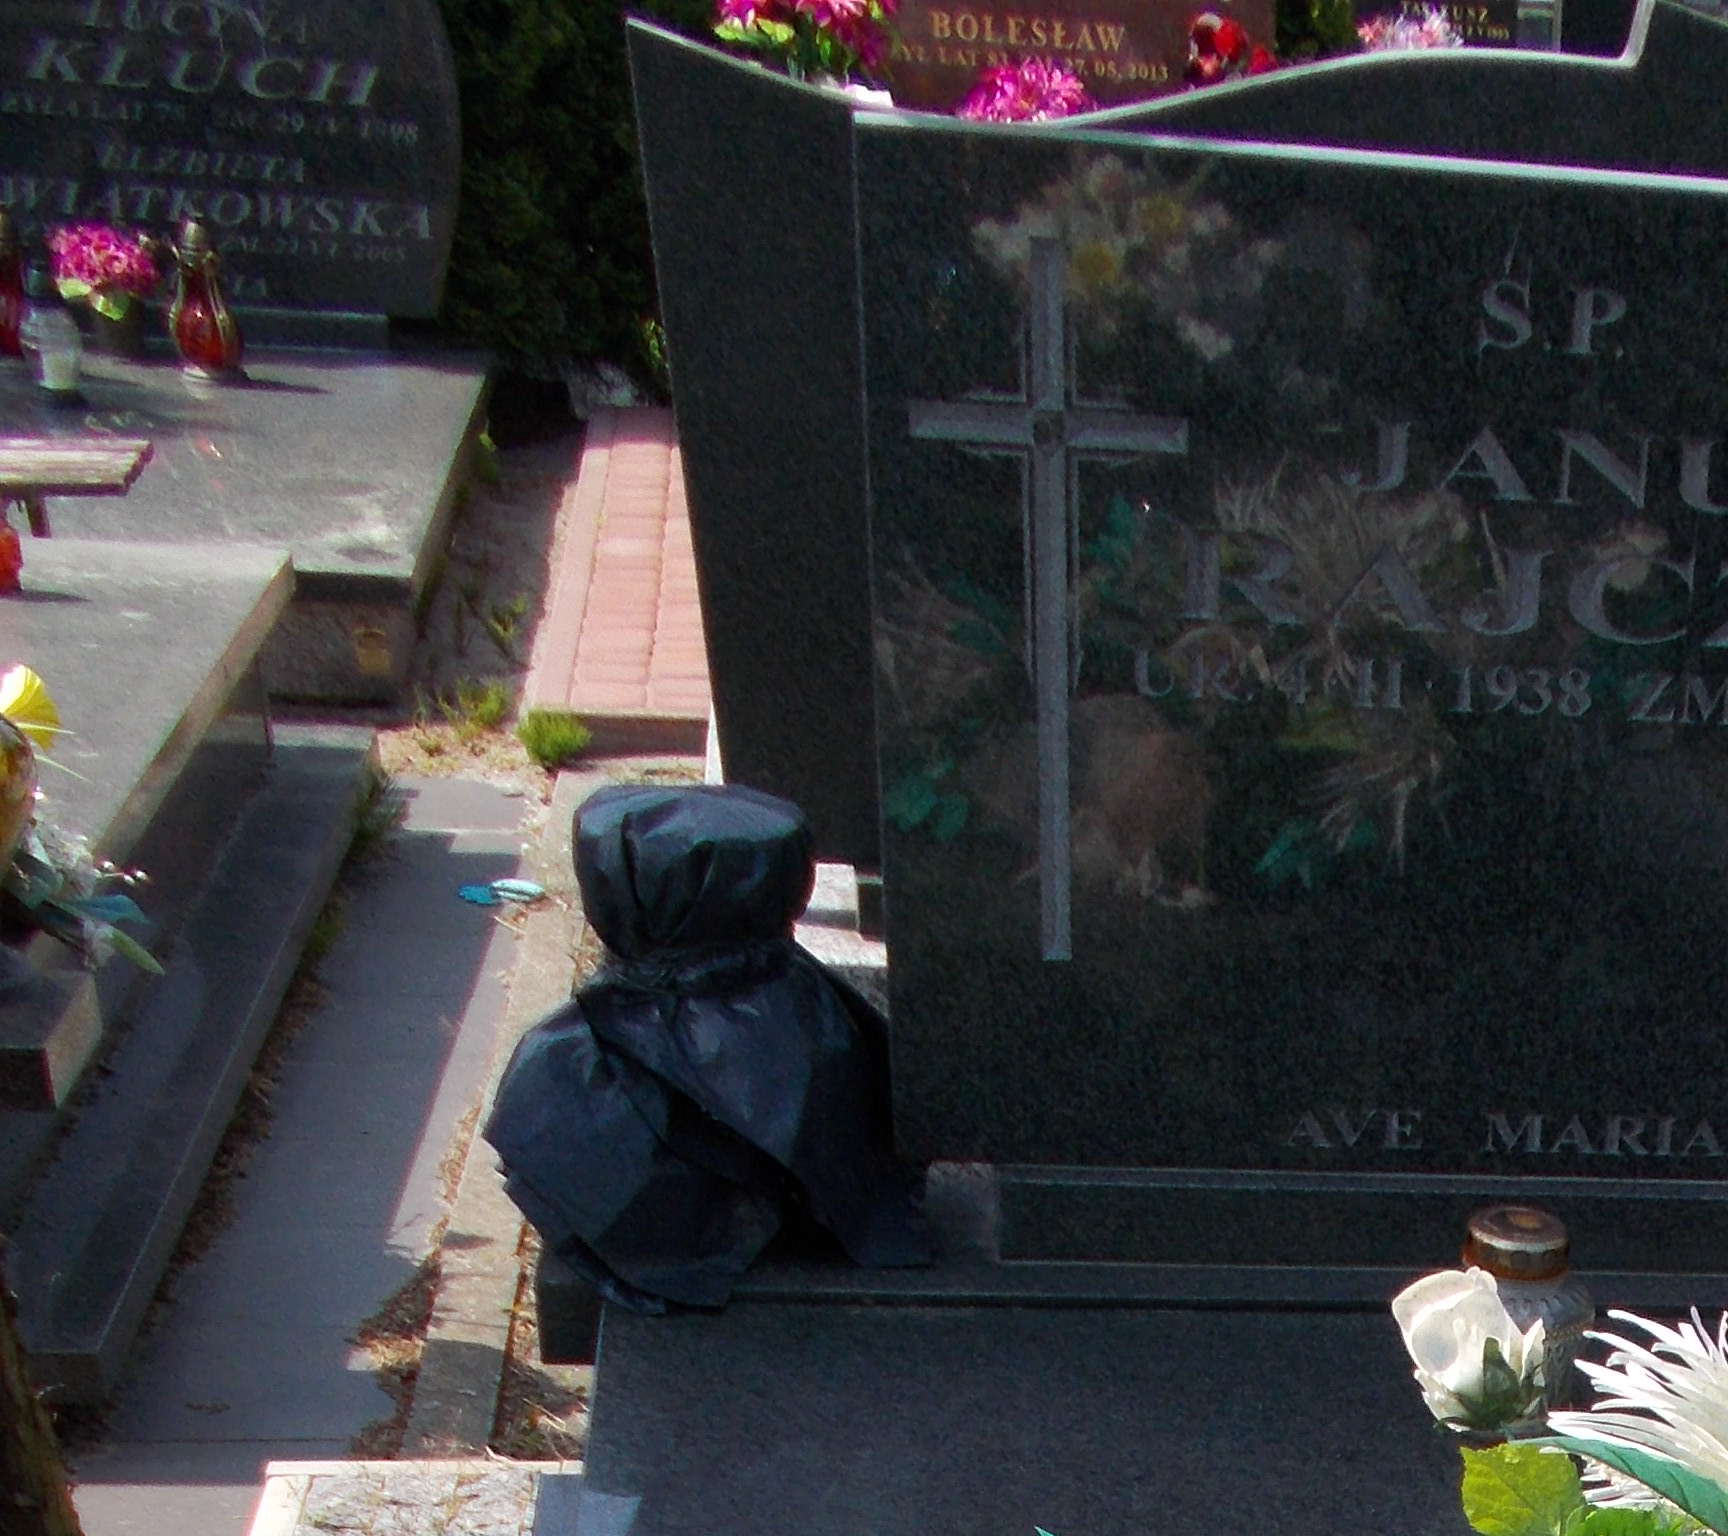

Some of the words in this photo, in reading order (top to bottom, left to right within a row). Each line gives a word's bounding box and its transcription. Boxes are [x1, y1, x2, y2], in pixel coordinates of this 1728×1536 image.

[930, 12, 1125, 53] BOLESŁAW
[26, 36, 379, 107] KLUCH
[1126, 63, 1168, 82] 2013
[1452, 666, 1592, 718] 1938
[1289, 1108, 1424, 1149] AVE
[1483, 1112, 1725, 1157] MARIA
